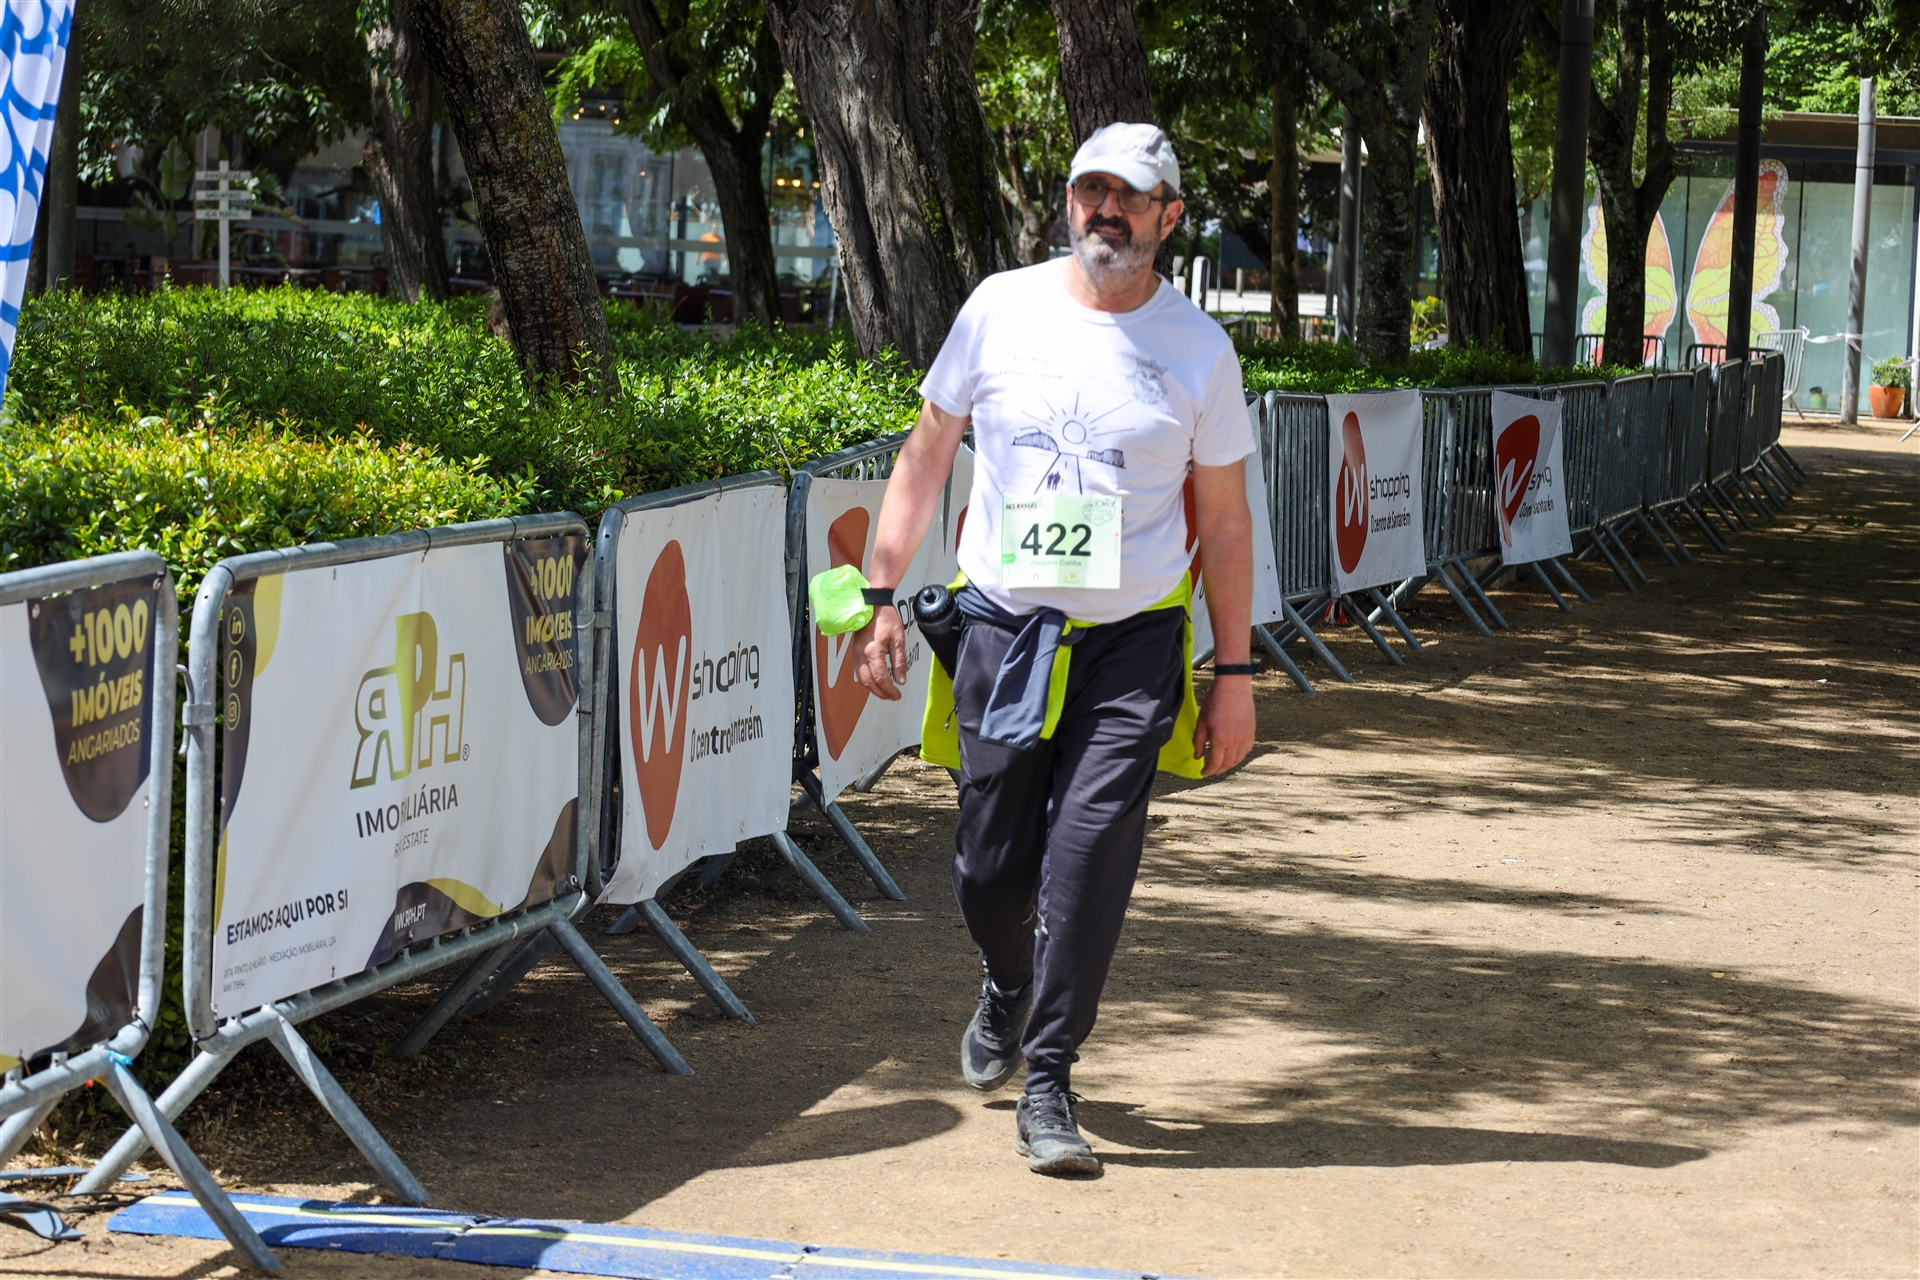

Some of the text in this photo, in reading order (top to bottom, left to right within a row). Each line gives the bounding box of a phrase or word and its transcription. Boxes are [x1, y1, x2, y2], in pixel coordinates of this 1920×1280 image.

[1370, 472, 1410, 502] shopping
[1374, 516, 1386, 532] centro
[1387, 511, 1391, 530] de
[1391, 507, 1410, 529] Santarém
[1020, 523, 1092, 557] 422
[530, 554, 573, 600] +1000
[1029, 559, 1057, 567] Joaquim
[70, 599, 148, 667] +1000
[71, 669, 143, 728] IMÓVEIS
[67, 718, 140, 766] ANGARIADOS
[696, 726, 731, 758] centro
[731, 705, 763, 747] antarém
[402, 828, 430, 851] ESTATE
[227, 888, 348, 945] ESTAMOS AQUI POR SI
[269, 946, 298, 963] MEDIAÇÃO
